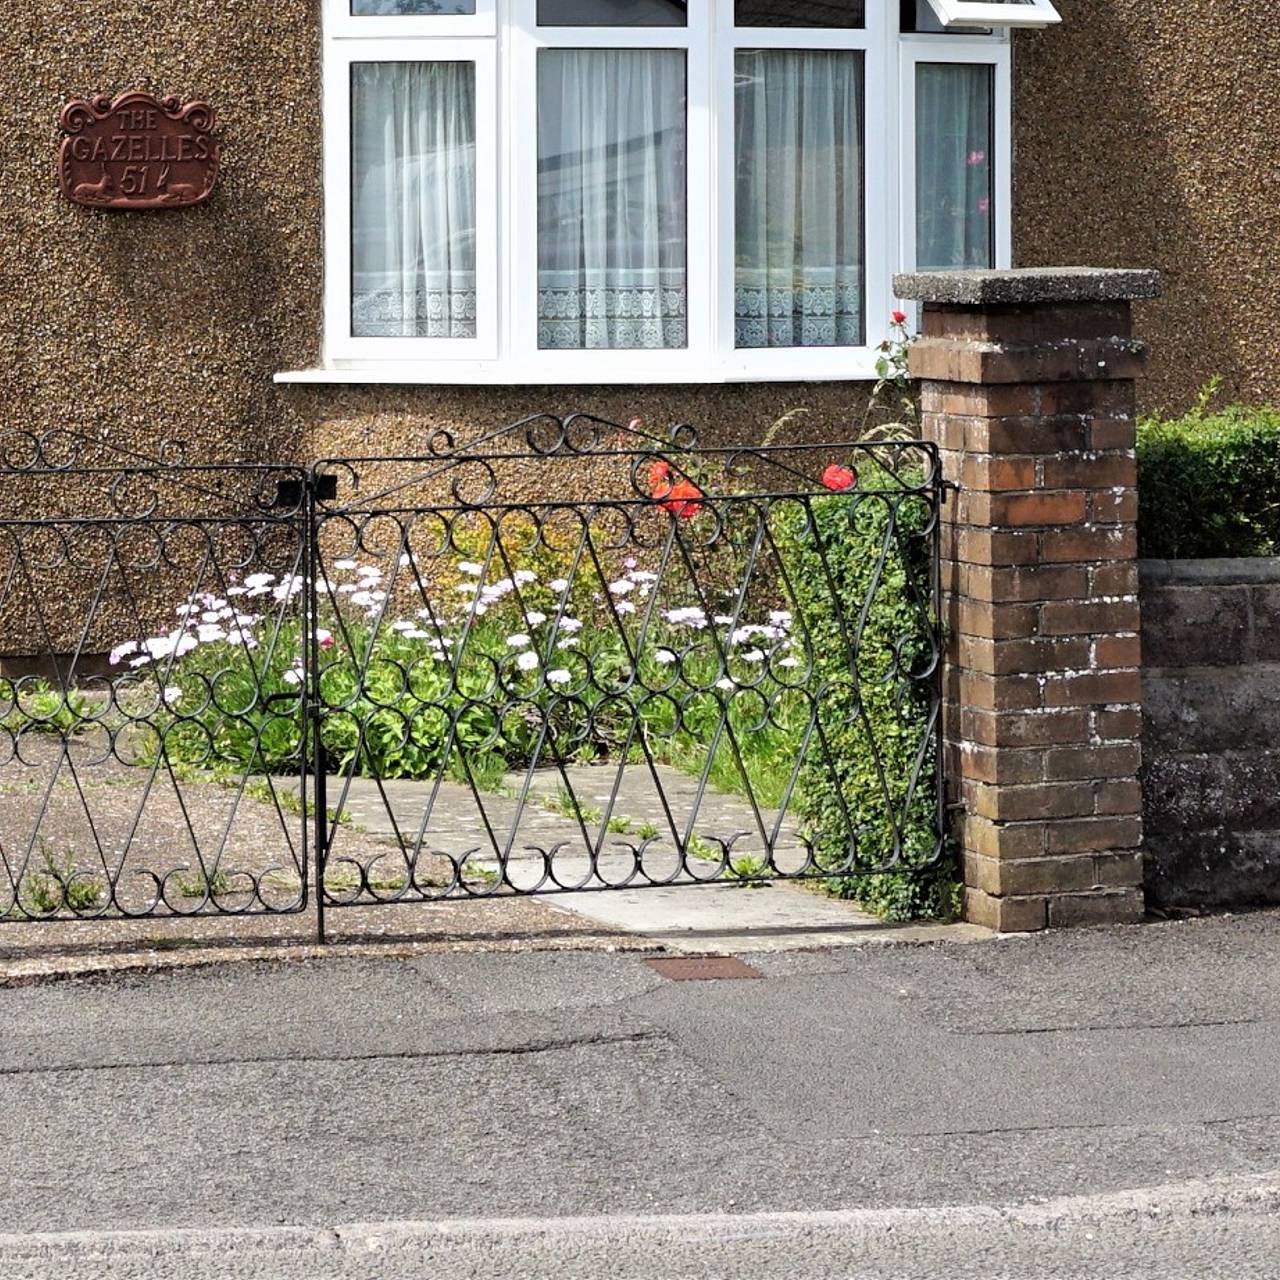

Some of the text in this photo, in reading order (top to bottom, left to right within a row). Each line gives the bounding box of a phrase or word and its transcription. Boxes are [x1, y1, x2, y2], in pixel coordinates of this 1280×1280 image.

[117, 110, 158, 131] THE
[72, 135, 210, 162] GAZELLES
[121, 166, 149, 195] 51
